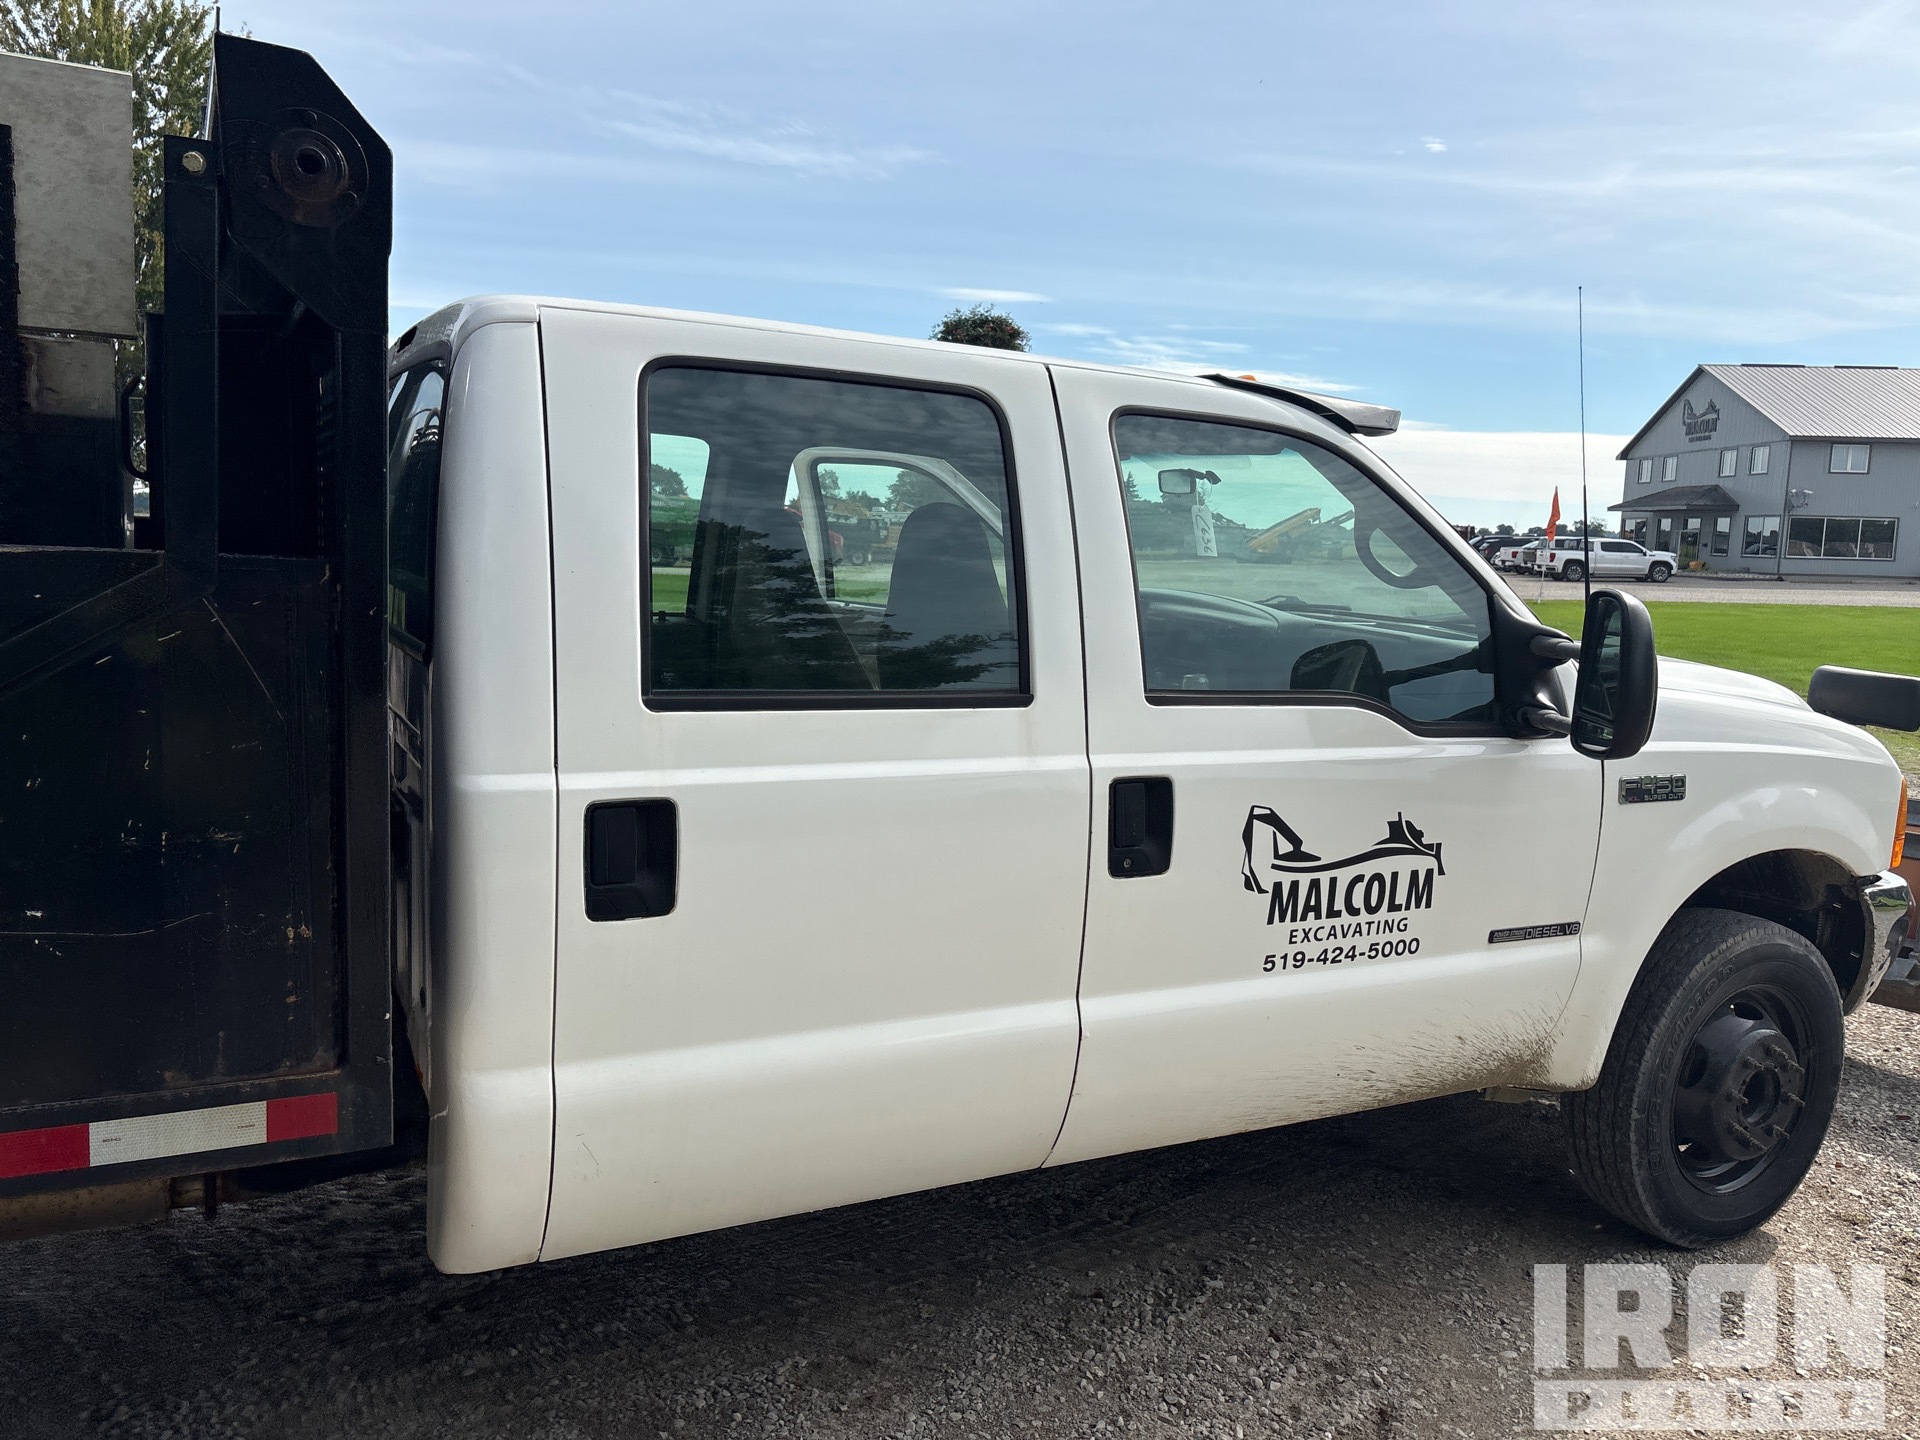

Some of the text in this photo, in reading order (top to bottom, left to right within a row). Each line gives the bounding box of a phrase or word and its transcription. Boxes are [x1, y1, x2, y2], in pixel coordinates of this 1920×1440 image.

[1668, 792, 1686, 800] DUTY
[1266, 868, 1435, 926] MALCOLM
[1288, 917, 1409, 945] EXCAVATING
[1526, 925, 1564, 939] DIESEL
[1565, 923, 1580, 935] V8
[1262, 937, 1421, 973] 519-424-5000
